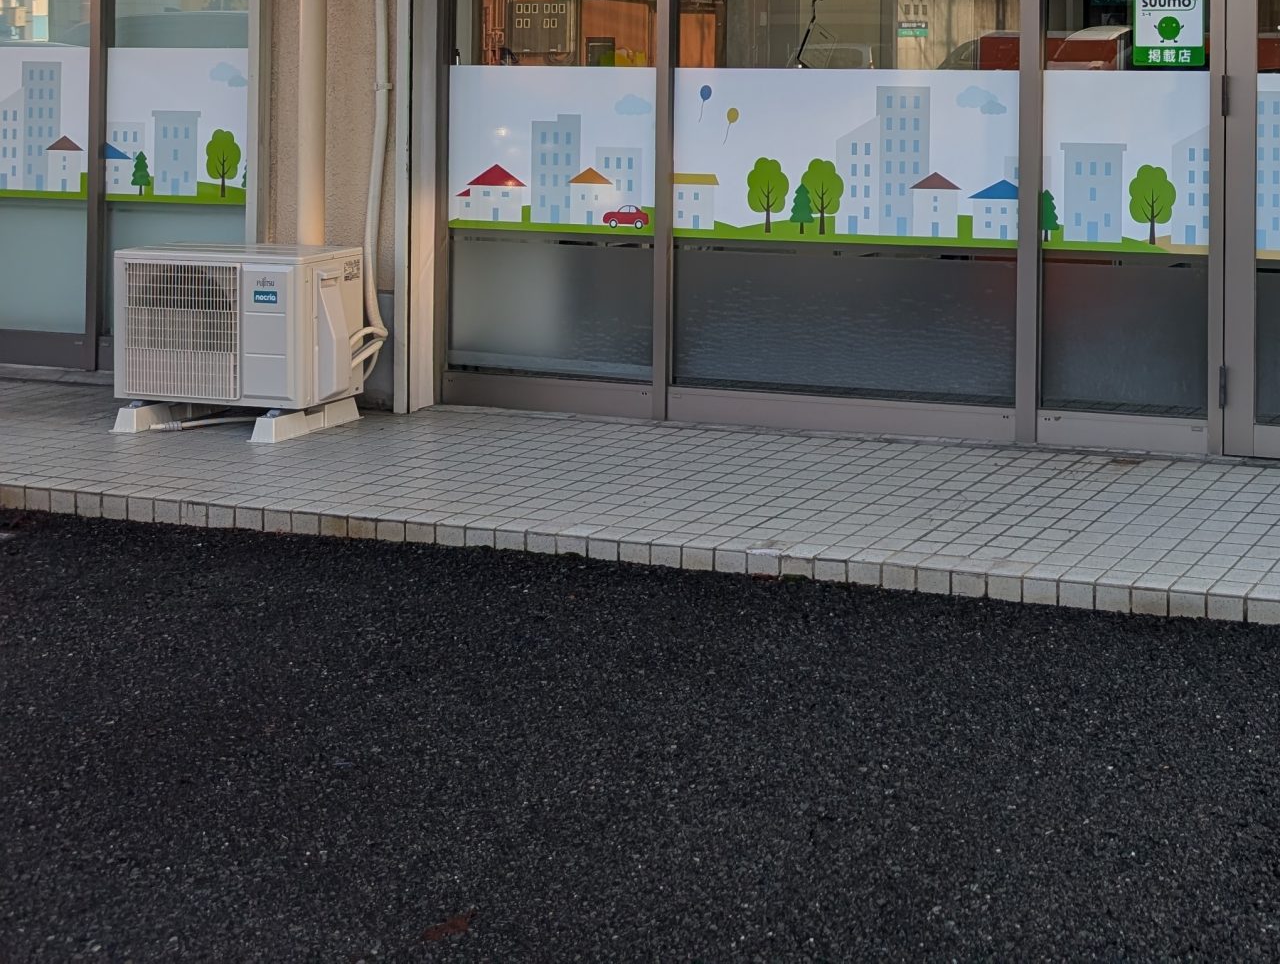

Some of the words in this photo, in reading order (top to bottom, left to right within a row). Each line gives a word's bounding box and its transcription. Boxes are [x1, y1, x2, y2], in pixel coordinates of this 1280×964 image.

[1148, 49, 1191, 63] 掲載店
[256, 277, 275, 288] FUJITSU
[255, 293, 276, 301] nocria
